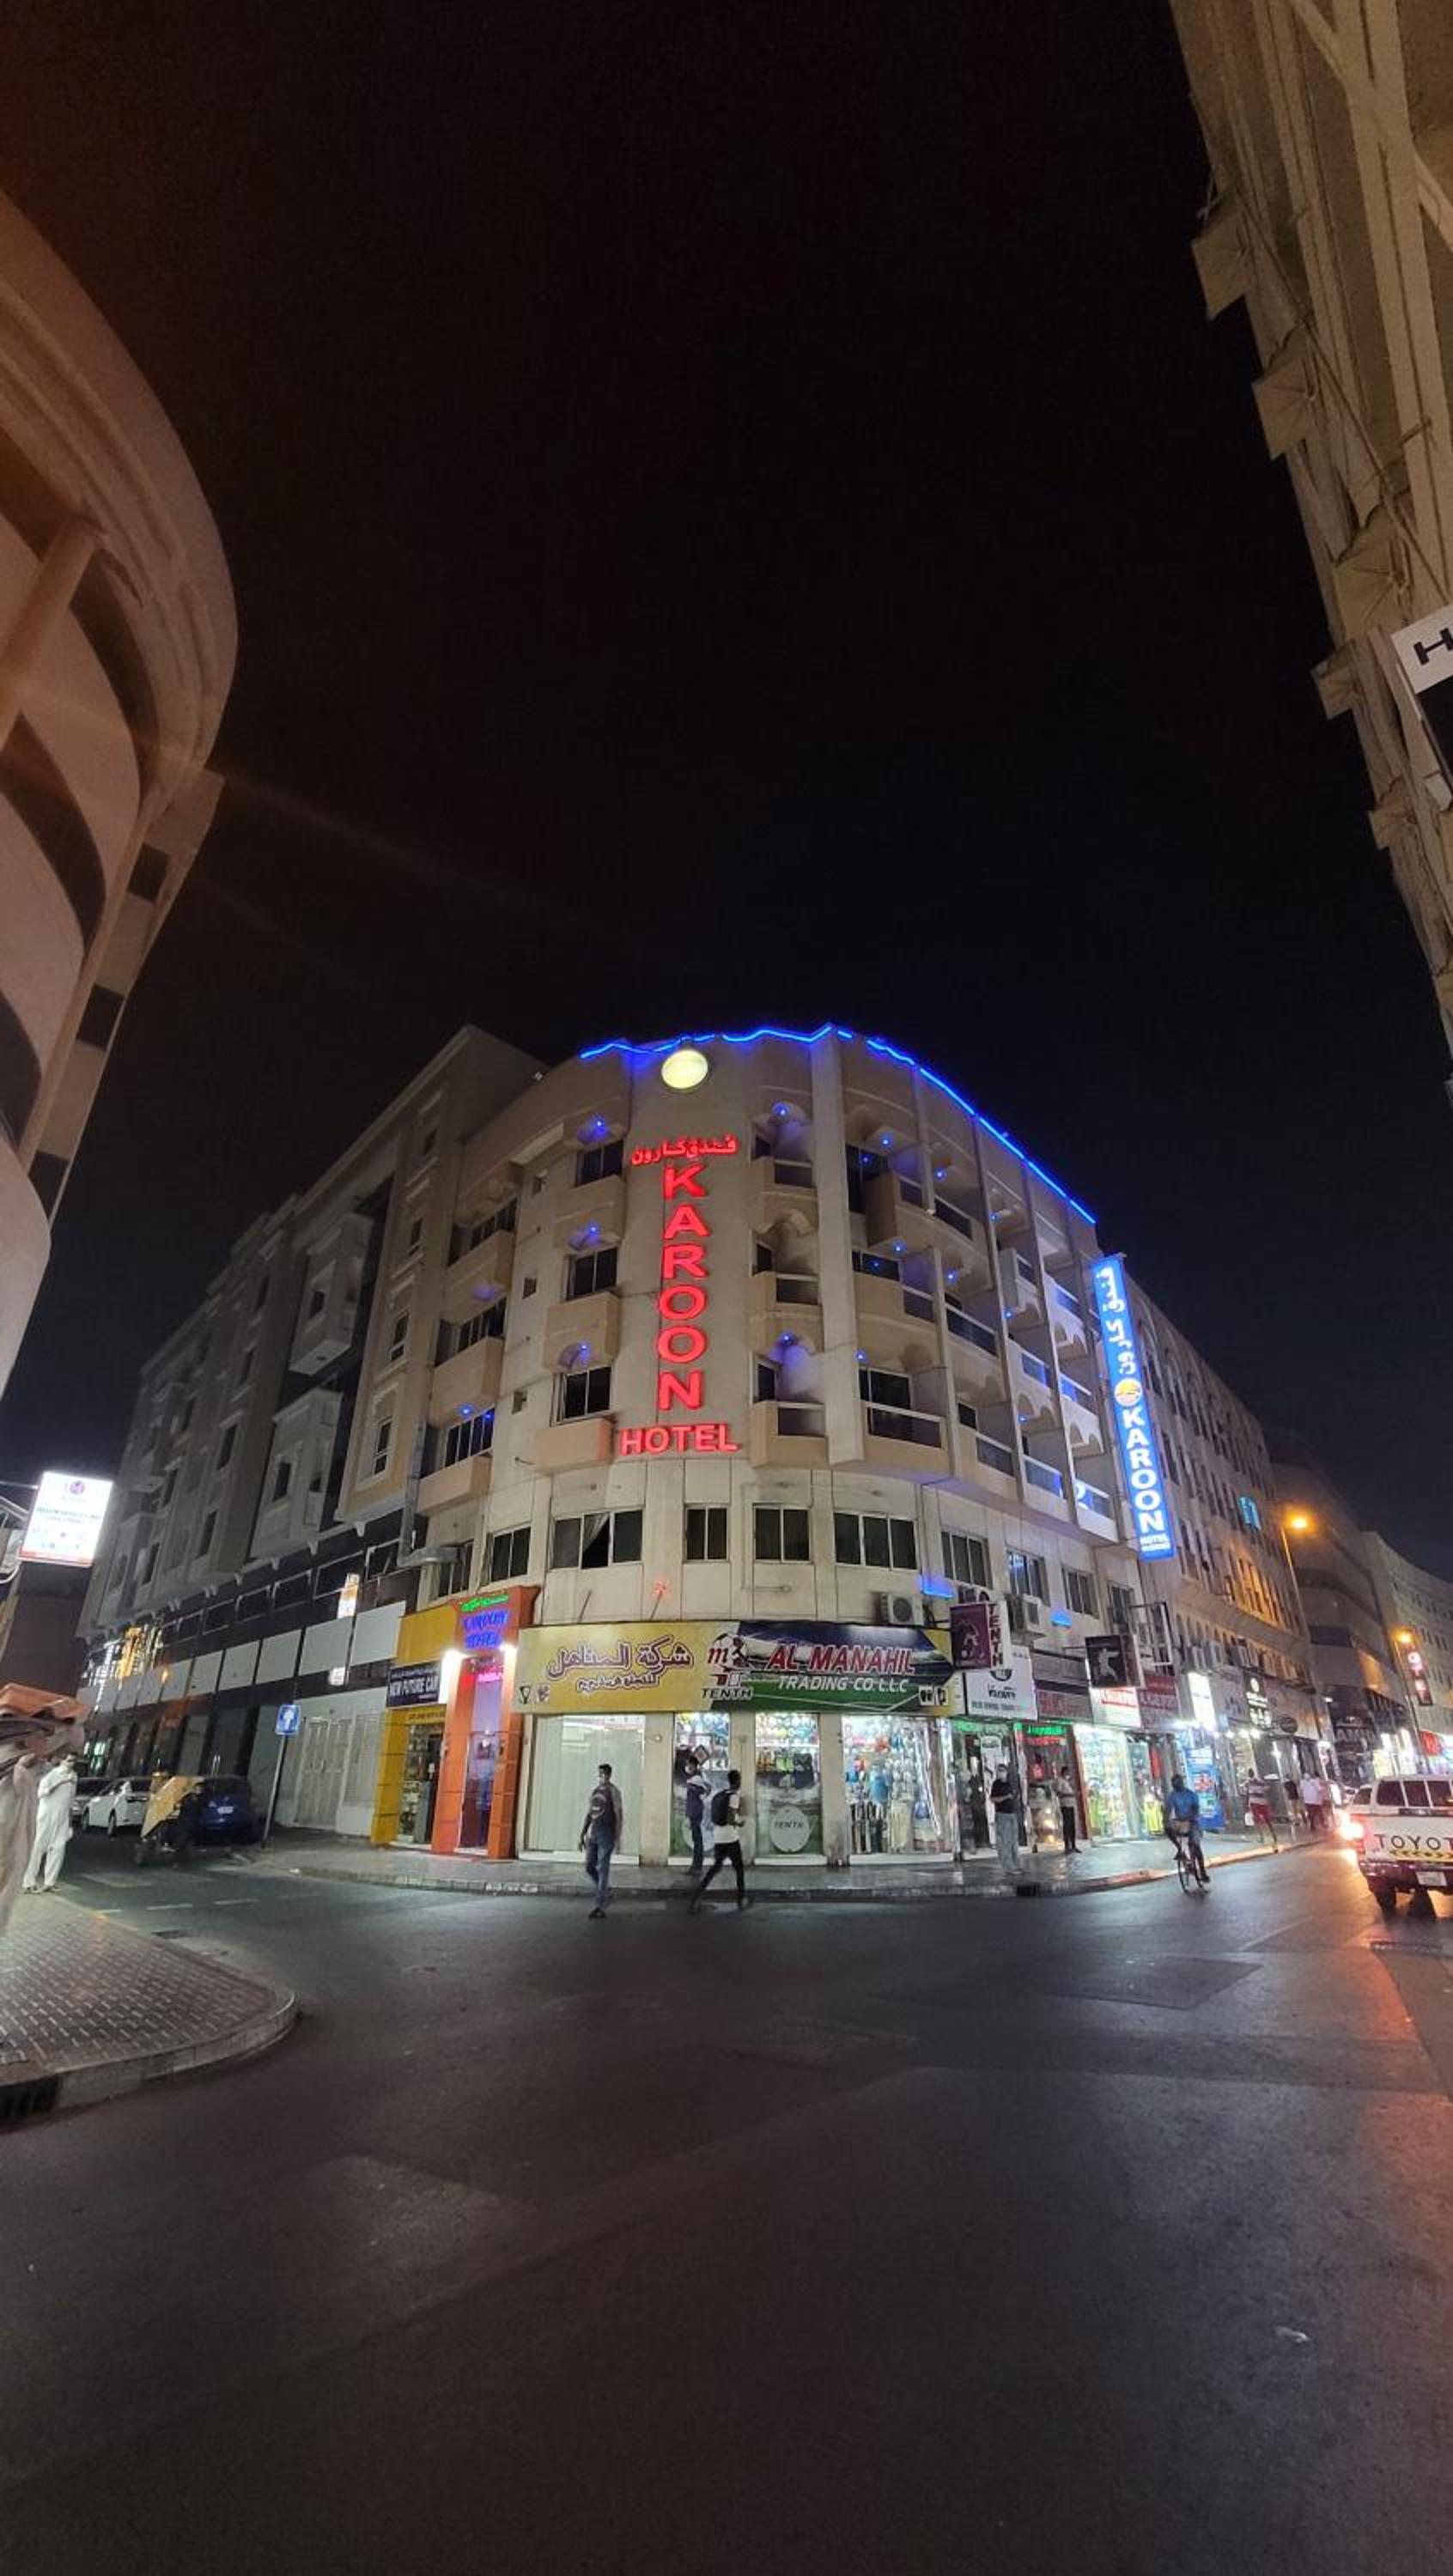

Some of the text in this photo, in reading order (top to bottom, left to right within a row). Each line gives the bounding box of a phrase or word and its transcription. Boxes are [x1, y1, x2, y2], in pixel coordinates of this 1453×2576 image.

[631, 1134, 737, 1165] فندق كارون
[657, 1162, 710, 1411] KAROON
[620, 1422, 741, 1456] HOTEL
[1122, 1406, 1166, 1534] KAROON
[988, 1603, 1004, 1666] TENTH
[546, 1634, 694, 1680] شركة المناهل
[766, 1643, 915, 1675] AL MANAHIL
[702, 1688, 752, 1699] TENTH
[778, 1675, 848, 1691] TRADING
[853, 1677, 875, 1692] CO.
